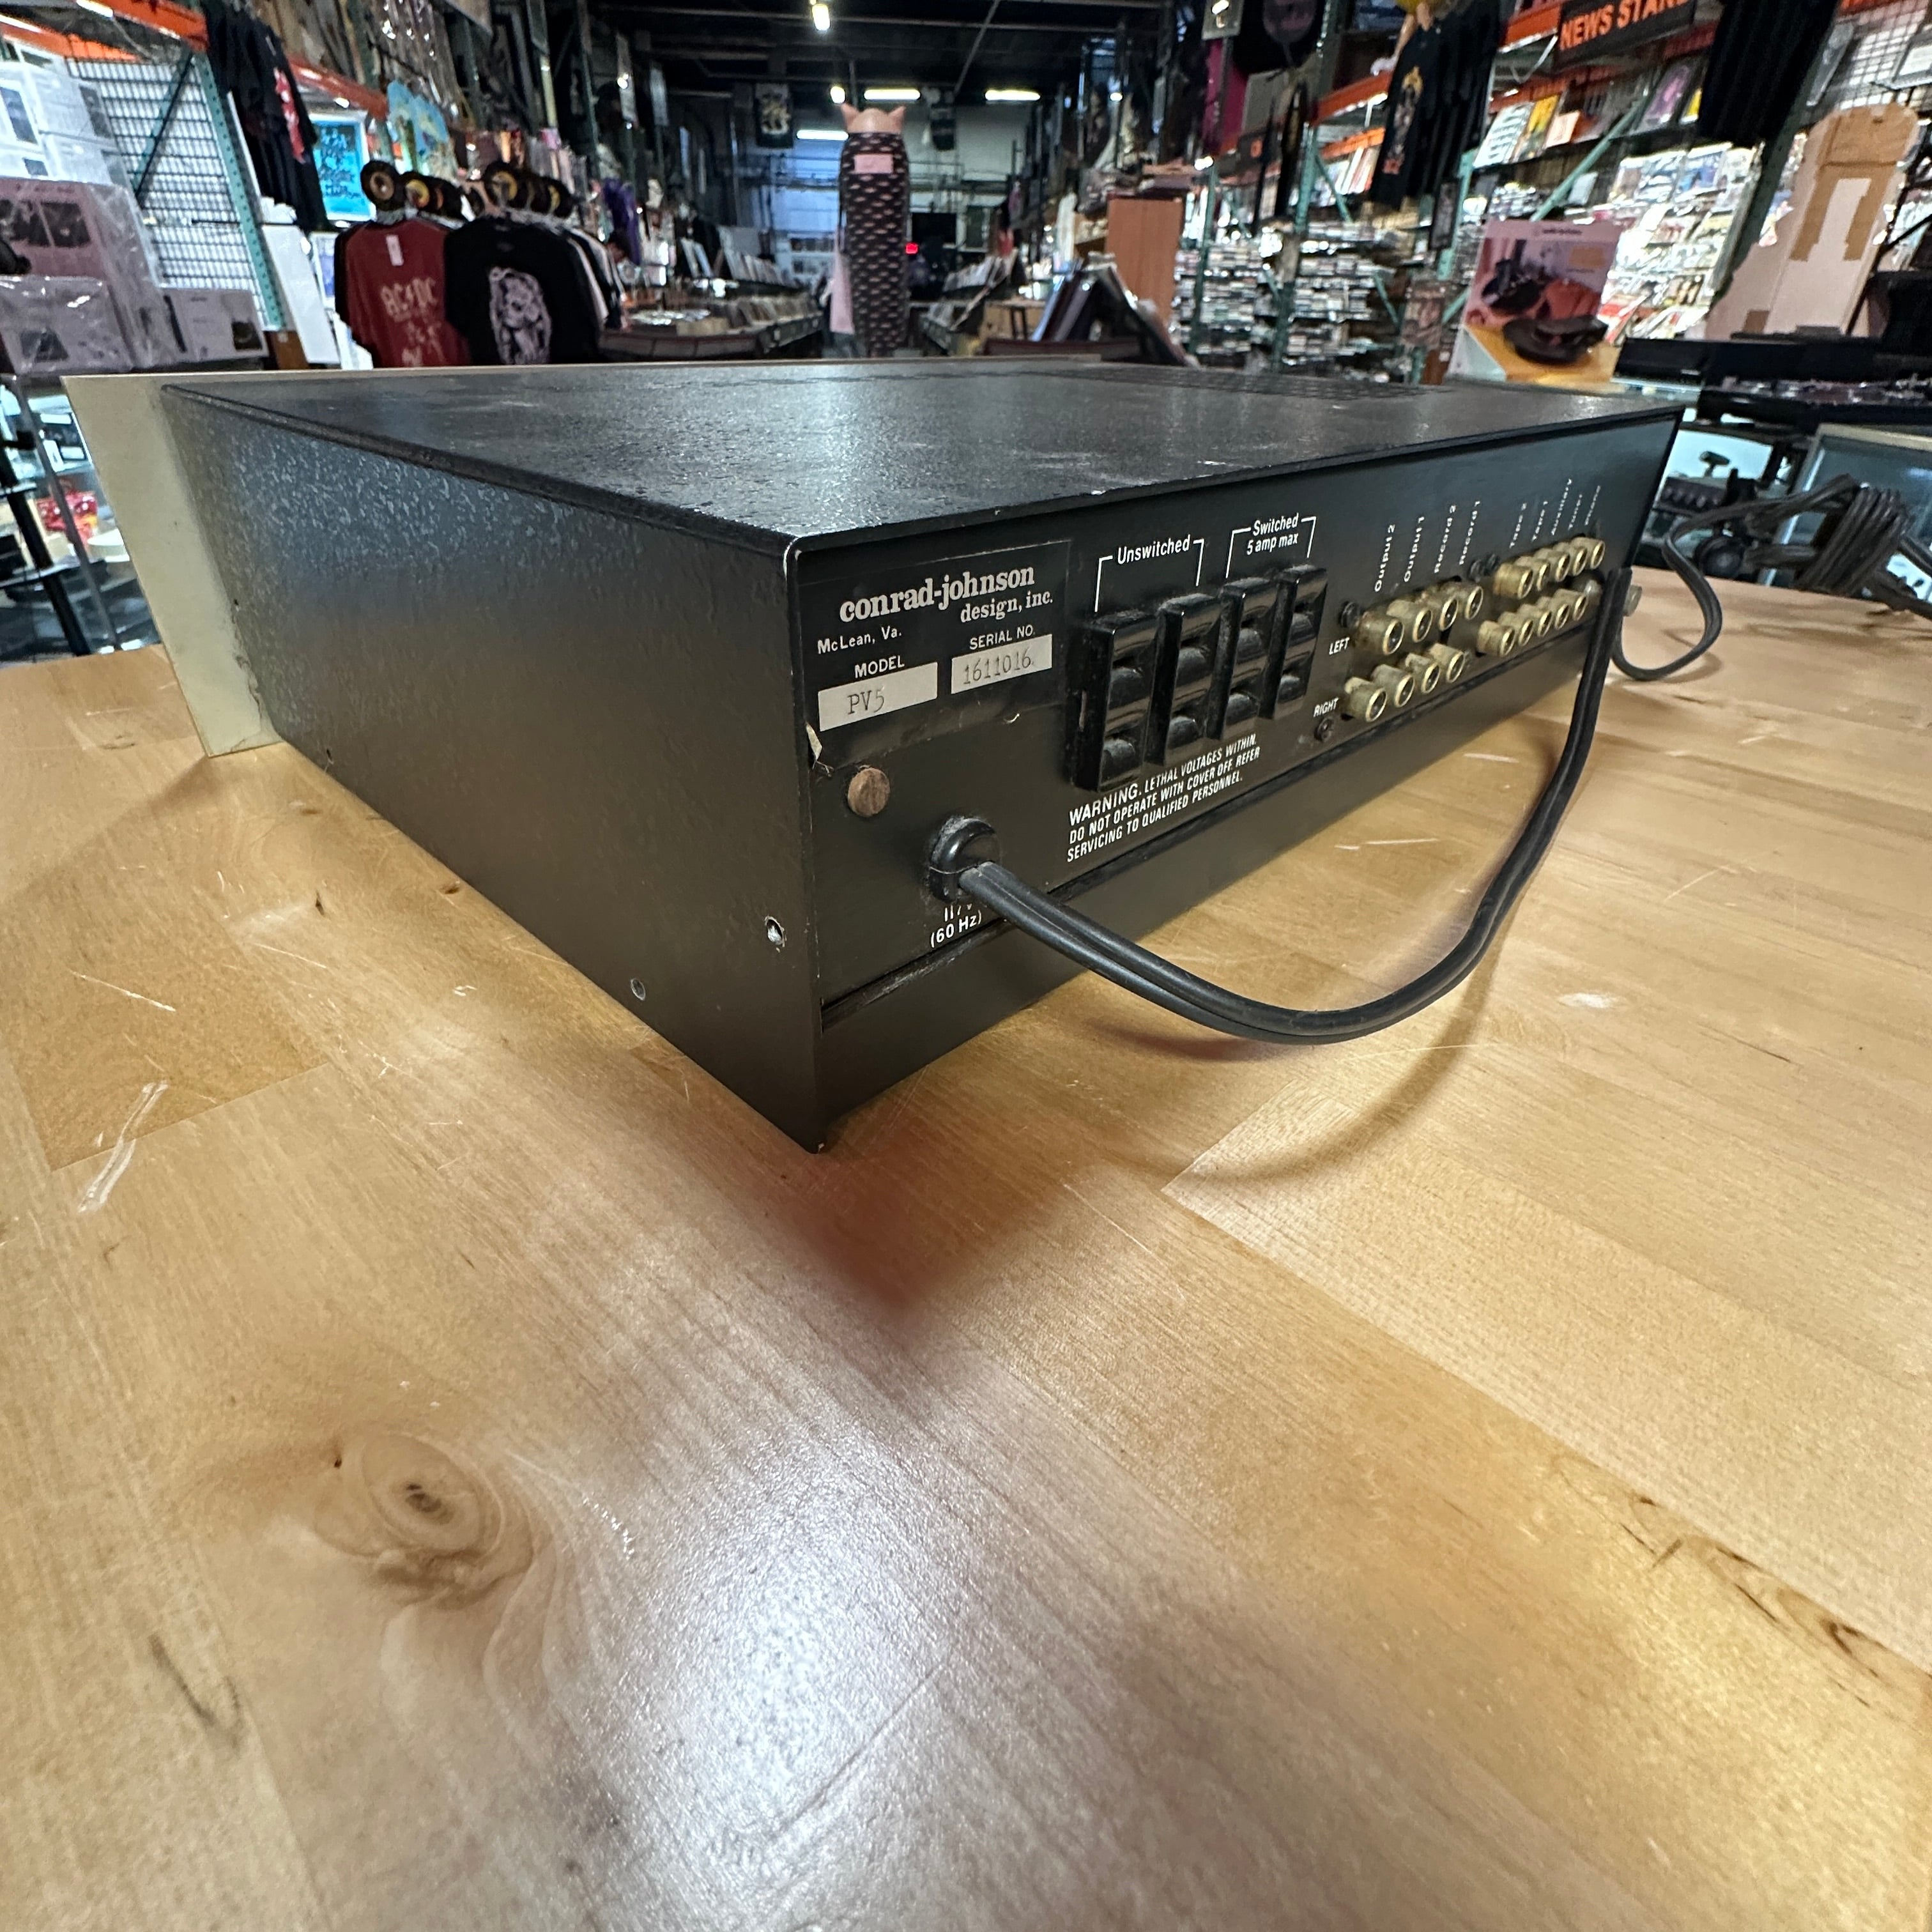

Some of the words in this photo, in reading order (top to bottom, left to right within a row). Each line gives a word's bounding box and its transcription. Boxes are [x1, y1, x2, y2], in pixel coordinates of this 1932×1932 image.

[1560, 4, 1614, 50] NEWS
[1253, 512, 1299, 536] Switched
[1459, 510, 1478, 565] Record
[1118, 534, 1190, 564] Unswitched
[1246, 539, 1254, 555] 5
[1255, 537, 1277, 553] amp
[1278, 533, 1298, 548] max
[1375, 537, 1392, 592] Output
[1388, 524, 1395, 533] 2
[1404, 527, 1422, 582] Output
[1434, 518, 1453, 573] Record
[840, 567, 1035, 622] conrad-johnson
[960, 598, 1022, 623] design,
[1025, 590, 1053, 608] inc.
[818, 634, 875, 654] McLean,
[881, 625, 901, 640] Va.
[970, 630, 1012, 650] SERIAL
[1329, 637, 1350, 655] LEFT
[855, 656, 905, 678] MODEL
[847, 689, 885, 715] PV5
[1314, 697, 1339, 717] RIGHT
[1070, 783, 1142, 826] WARNING.
[1145, 767, 1178, 793] LETHAL
[1181, 747, 1222, 776] VOLTAGES
[1070, 826, 1084, 844] DO
[1089, 814, 1110, 836] NOT
[1114, 792, 1157, 824] OPERATE
[1160, 781, 1184, 802] WITH
[1186, 767, 1215, 790] COVER
[1236, 746, 1261, 767] REFER
[1067, 825, 1123, 862] SERVICING
[1126, 818, 1139, 835] TO
[1142, 794, 1188, 827] QUALIFIED
[1192, 770, 1243, 803] PERSONNEL.
[930, 923, 954, 948] (60
[958, 910, 982, 933] Hz)
